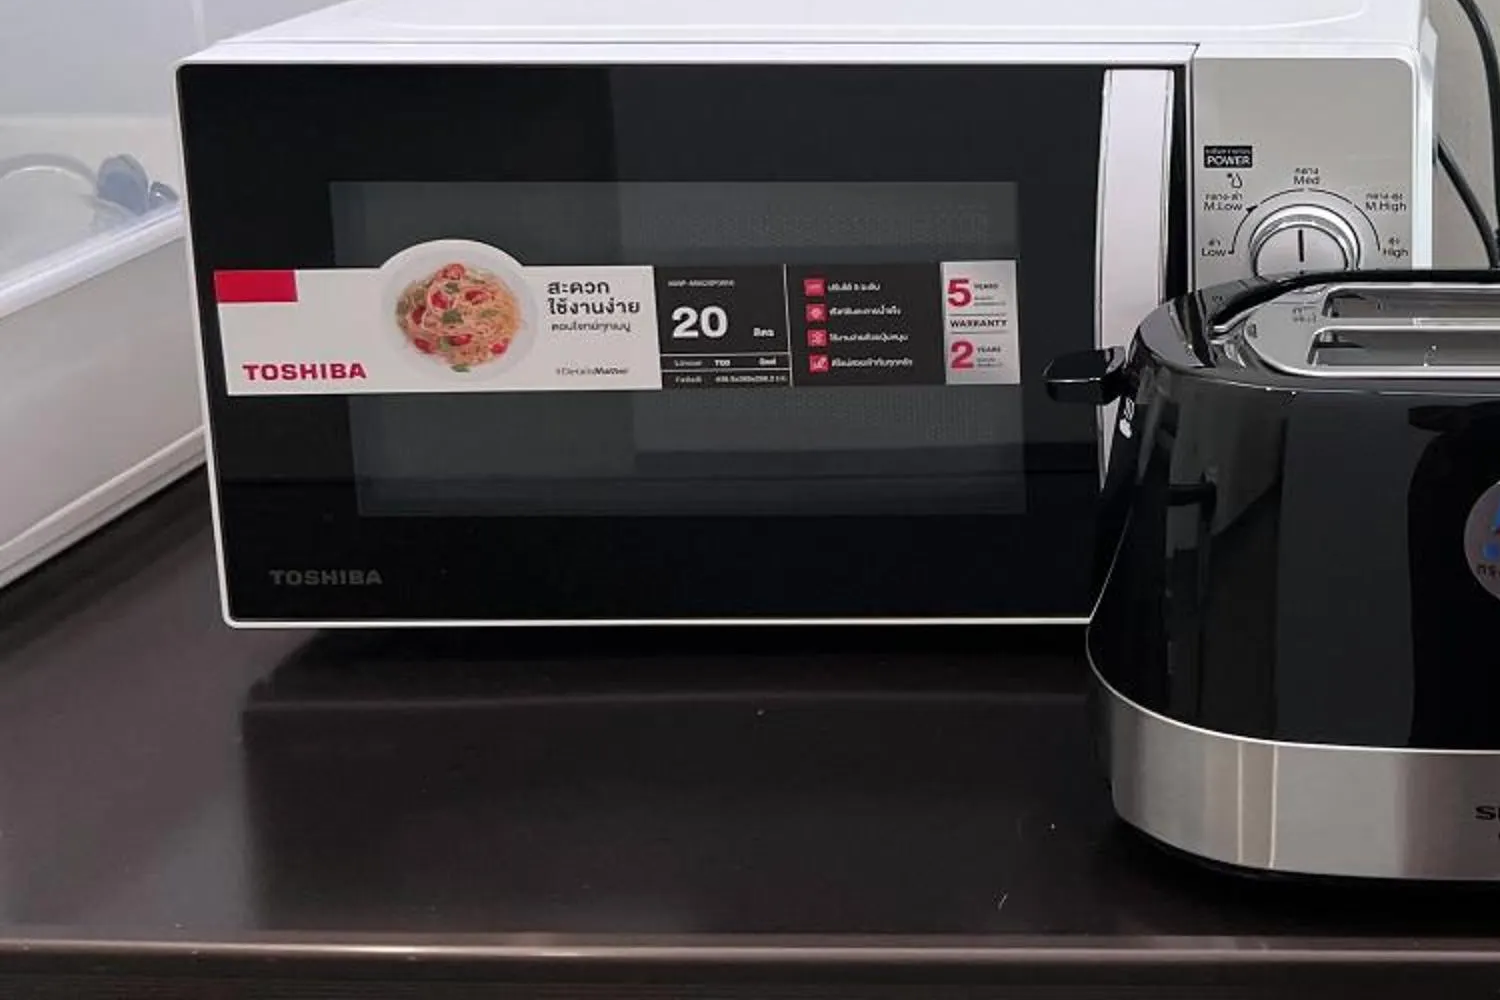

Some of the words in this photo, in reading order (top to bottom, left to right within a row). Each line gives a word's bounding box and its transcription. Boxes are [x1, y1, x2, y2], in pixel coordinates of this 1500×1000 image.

[1206, 155, 1251, 167] POWER
[1293, 176, 1320, 185] Med
[1203, 202, 1242, 211] M.Low
[1365, 201, 1407, 212] M.High
[1201, 248, 1226, 257] Low
[1383, 248, 1409, 258] High
[547, 281, 610, 295] สะดวก
[947, 278, 972, 307] 5
[547, 297, 641, 315] ใช้งานง่าย
[671, 306, 729, 338] 20
[949, 319, 1008, 328] WARRANTY
[951, 340, 975, 368] 2
[241, 363, 367, 381] TOSHIBA
[268, 568, 384, 586] TOSHIBA
